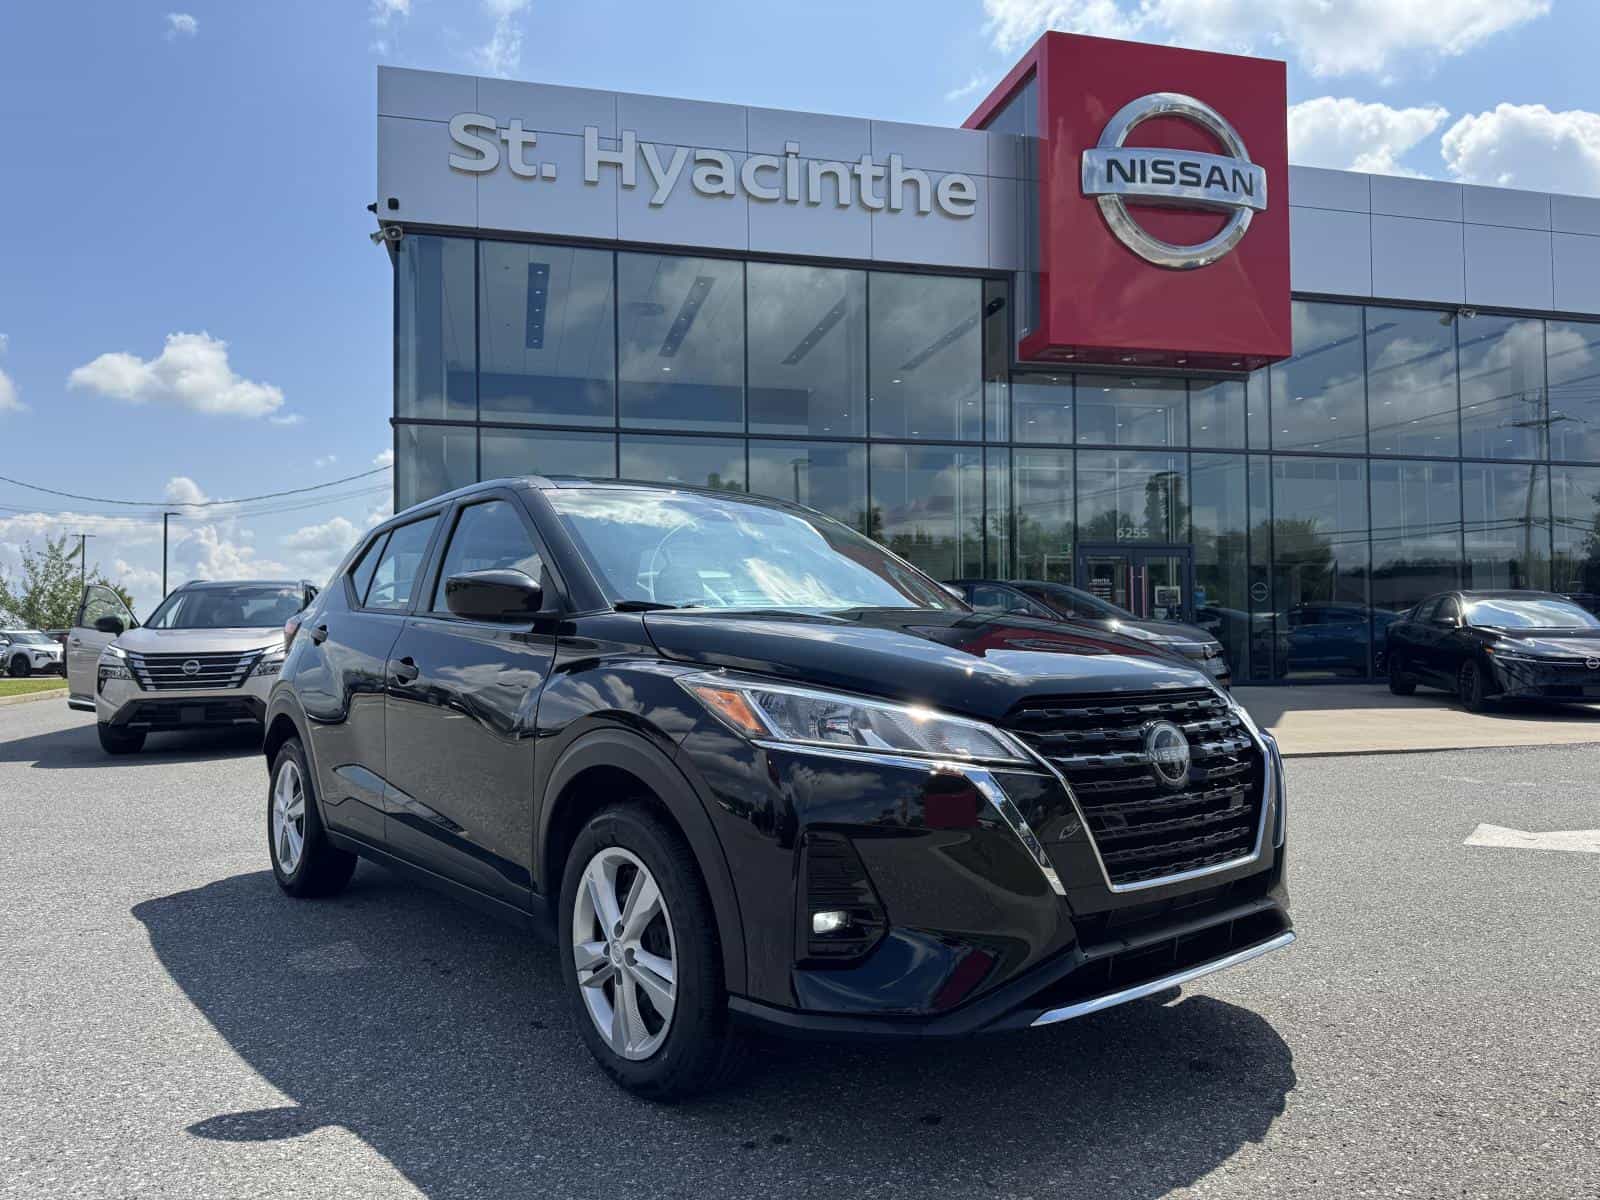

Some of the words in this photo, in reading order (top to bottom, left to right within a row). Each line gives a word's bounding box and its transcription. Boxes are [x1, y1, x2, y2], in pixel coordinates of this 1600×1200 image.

[448, 112, 557, 181] St.
[584, 125, 977, 215] Hyacinthe
[1106, 158, 1254, 196] NISSAN
